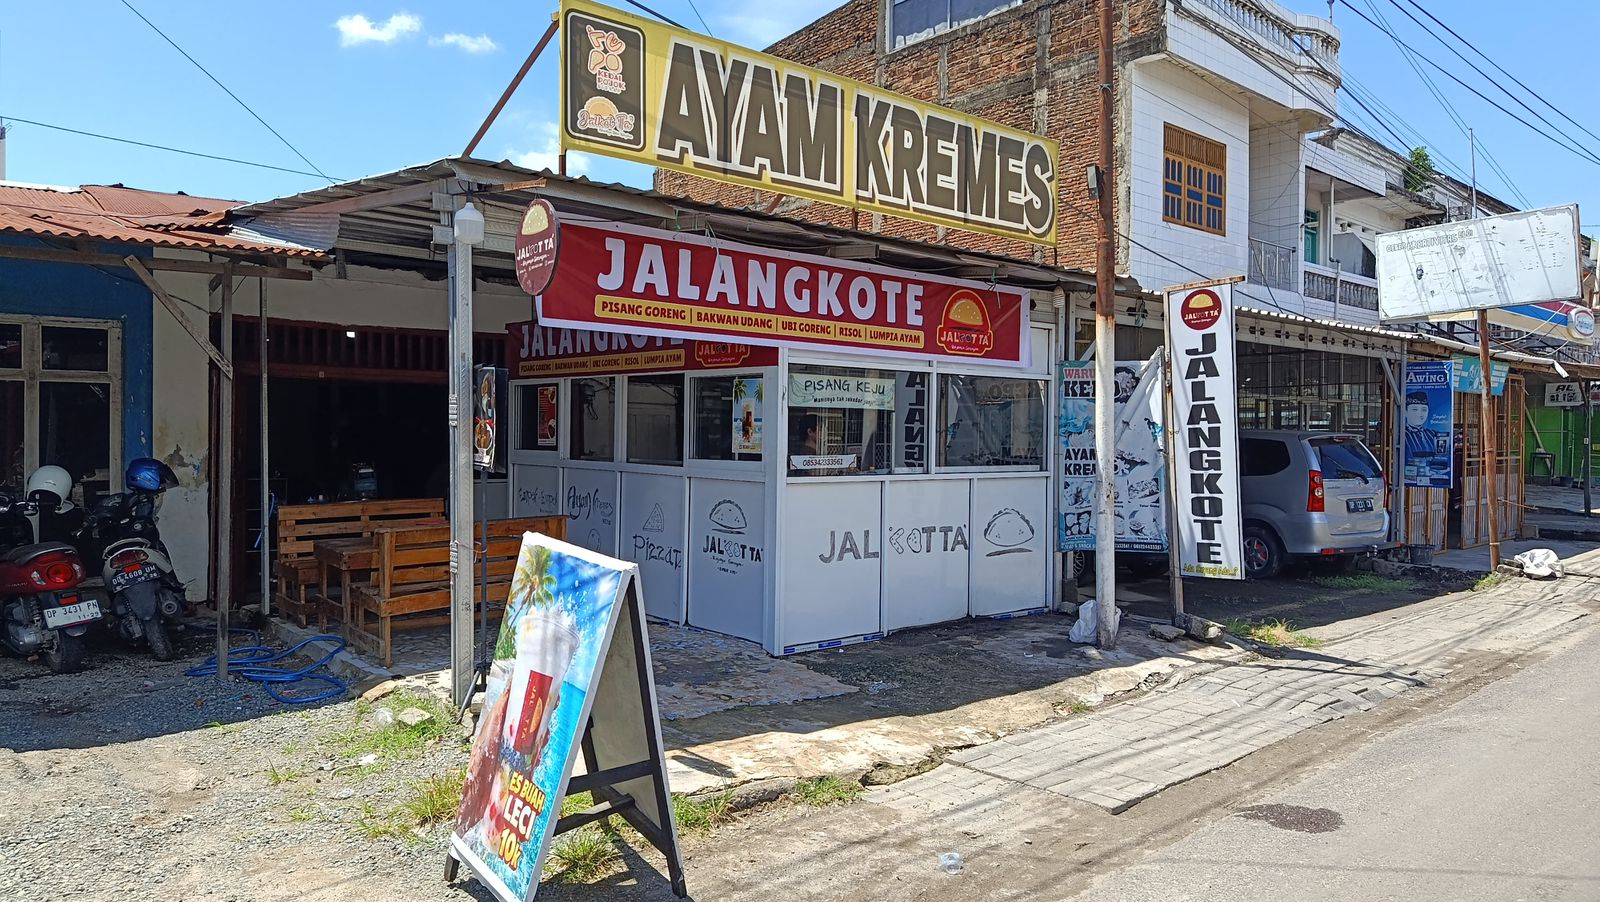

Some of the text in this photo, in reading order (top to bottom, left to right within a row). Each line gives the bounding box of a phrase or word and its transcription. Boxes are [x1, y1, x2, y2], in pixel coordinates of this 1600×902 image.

[656, 39, 1054, 233] AYAM KREMES
[596, 236, 924, 326] JALANGKOTE
[601, 300, 921, 344] PISANG GORENG BAKWAN UDANG UBI GORENG RISOL LUMPIA AYAM
[644, 354, 665, 364] LUMPIA
[665, 353, 682, 363] AYAM
[804, 379, 886, 395] PISANG KEJU
[1185, 332, 1224, 565] JALANGKOTE
[46, 601, 98, 619] DP 3431 PN
[509, 771, 546, 813] ES BUAH
[503, 794, 536, 840] LECI
